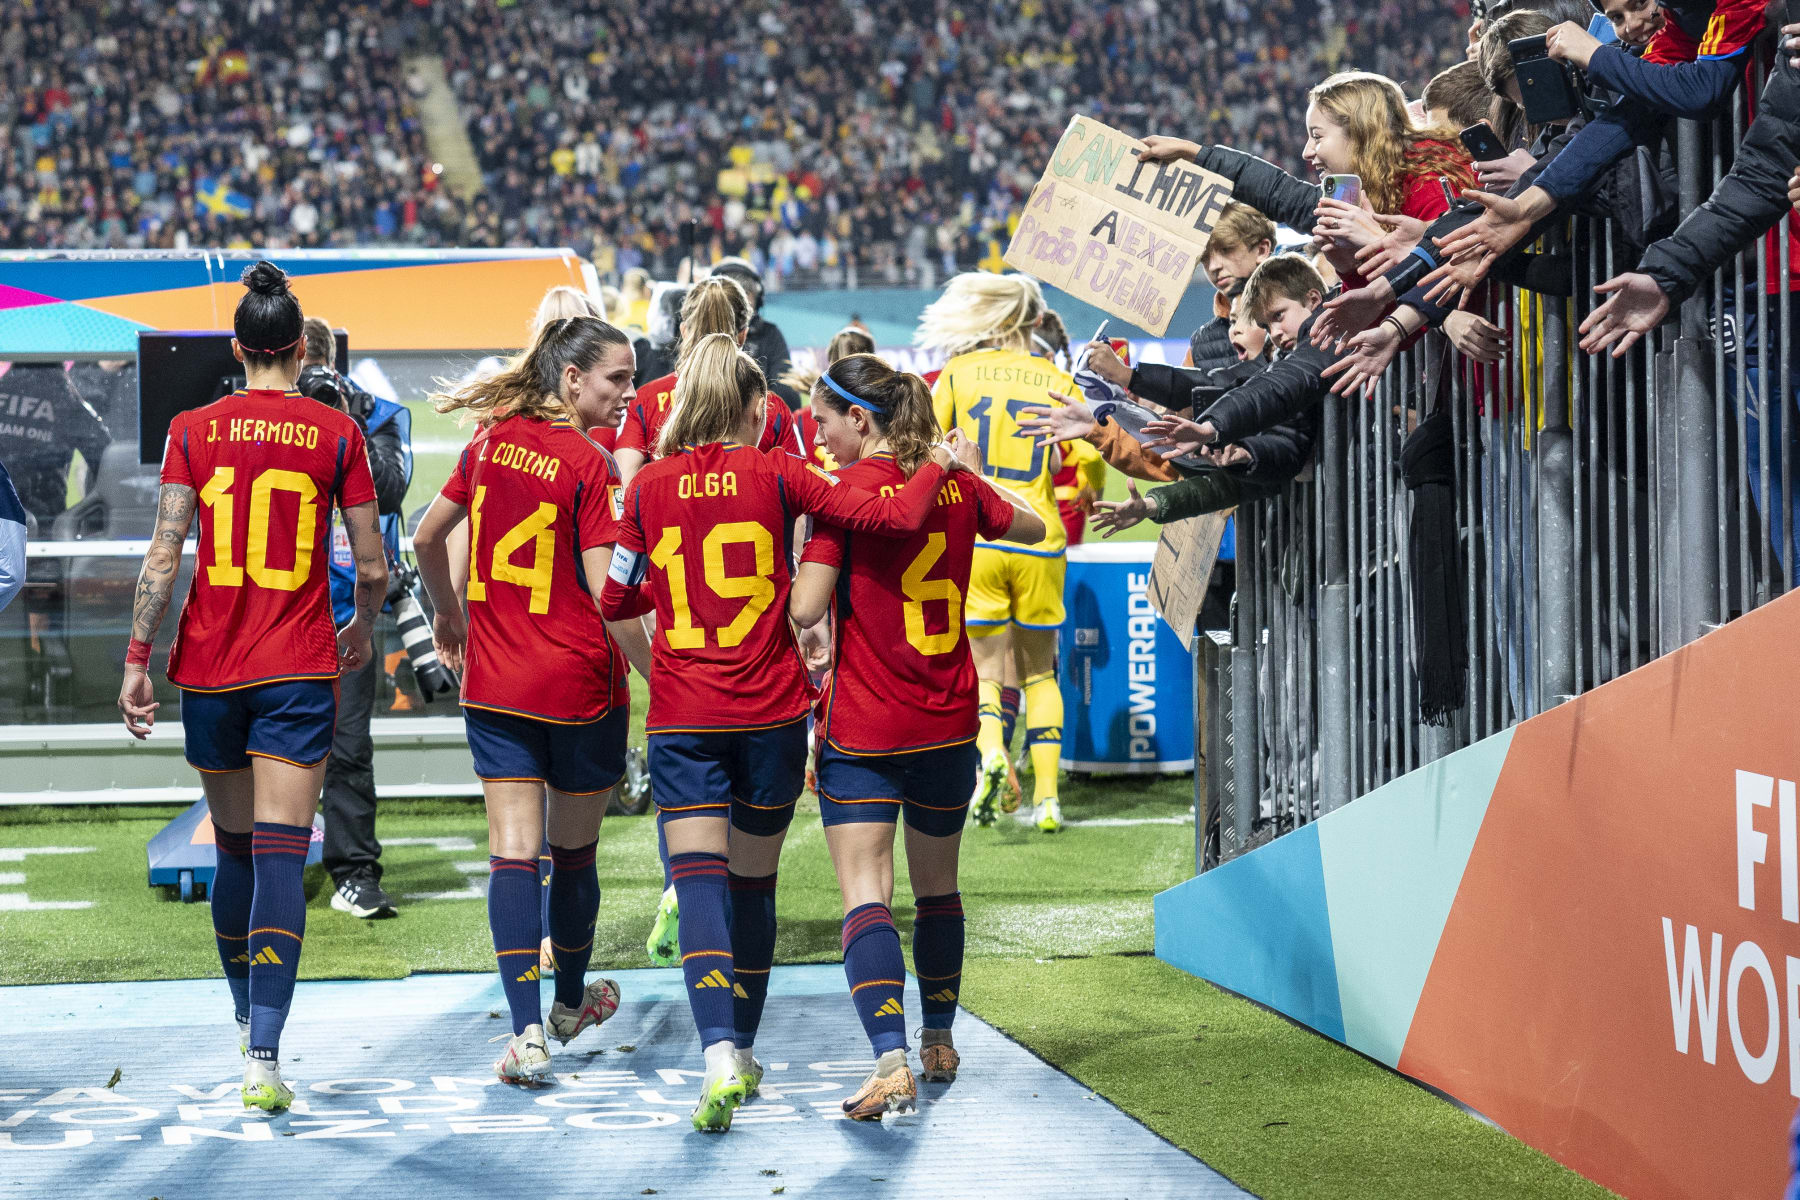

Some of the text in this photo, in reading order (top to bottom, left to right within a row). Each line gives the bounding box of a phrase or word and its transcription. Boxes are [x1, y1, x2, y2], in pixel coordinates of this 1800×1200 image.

[1032, 181, 1056, 214] A
[1053, 123, 1126, 185] CAN
[1145, 159, 1233, 235] HAVE
[976, 366, 1052, 389] ILESTEDT
[207, 418, 319, 450] J. HERMOSO
[491, 441, 561, 482] CODINA
[678, 471, 738, 499] OLGA
[200, 466, 319, 592] 10
[466, 485, 558, 615] 14
[649, 521, 776, 650] 19
[901, 531, 962, 656] 6
[1127, 572, 1158, 760] POWERADE
